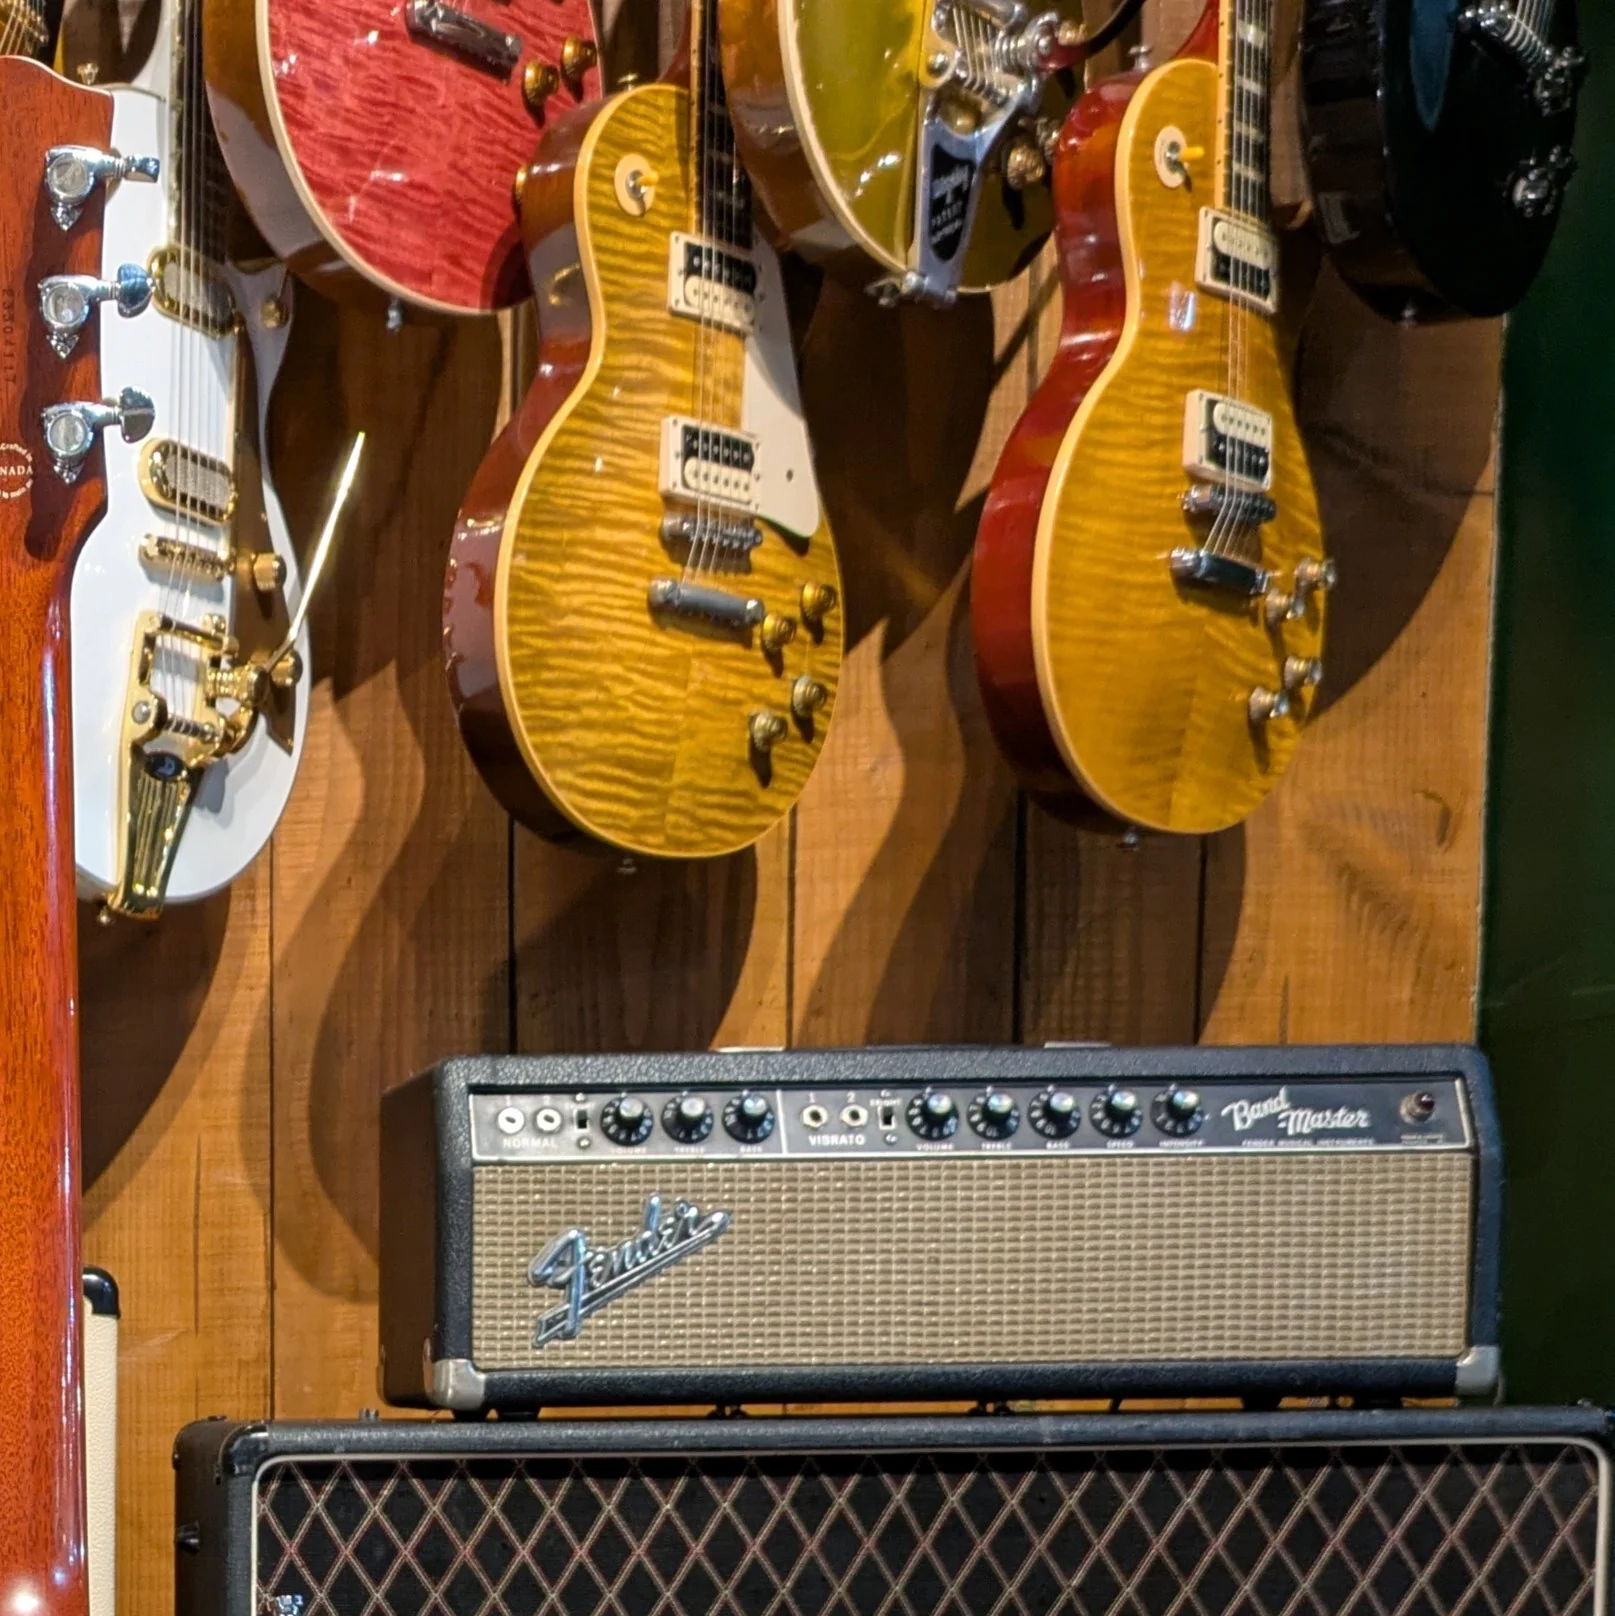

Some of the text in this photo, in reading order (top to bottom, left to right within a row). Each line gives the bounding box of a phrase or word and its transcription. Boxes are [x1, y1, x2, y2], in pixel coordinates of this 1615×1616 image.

[808, 1092, 816, 1103] 1
[846, 1091, 856, 1103] 2
[1221, 1085, 1291, 1131] Band
[1278, 1105, 1370, 1135] Master
[503, 1138, 558, 1149] NORMAL
[808, 1134, 865, 1146] VIBRATO
[916, 1143, 954, 1151] VOLUME
[528, 1192, 730, 1348] Fender
